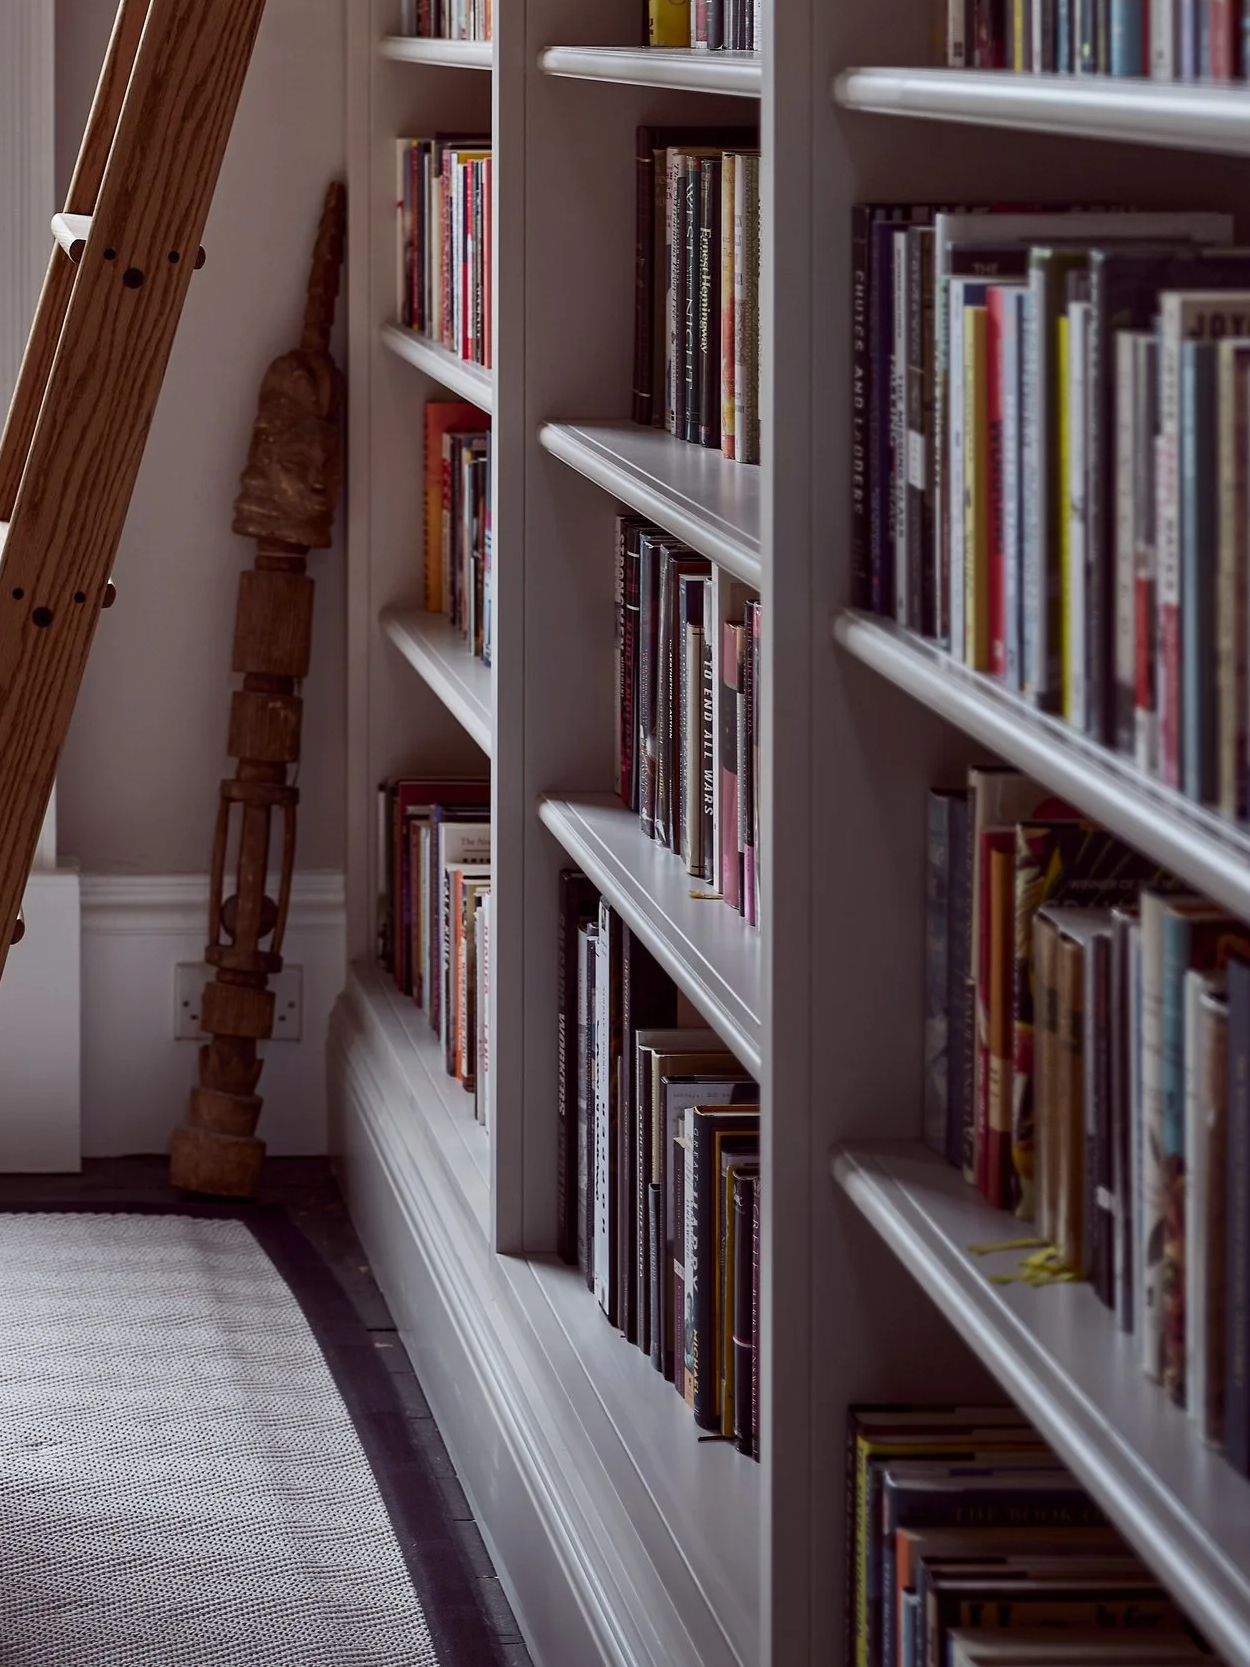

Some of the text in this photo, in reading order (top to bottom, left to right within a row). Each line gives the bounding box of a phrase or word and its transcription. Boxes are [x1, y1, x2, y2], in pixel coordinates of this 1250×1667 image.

[700, 227, 711, 353] Ernest Hemingway
[853, 269, 864, 514] CHUTES AND LADDERS
[704, 660, 713, 816] TO END ALL WARS
[951, 1507, 993, 1522] THE
[1009, 1506, 1071, 1521] BOOK
